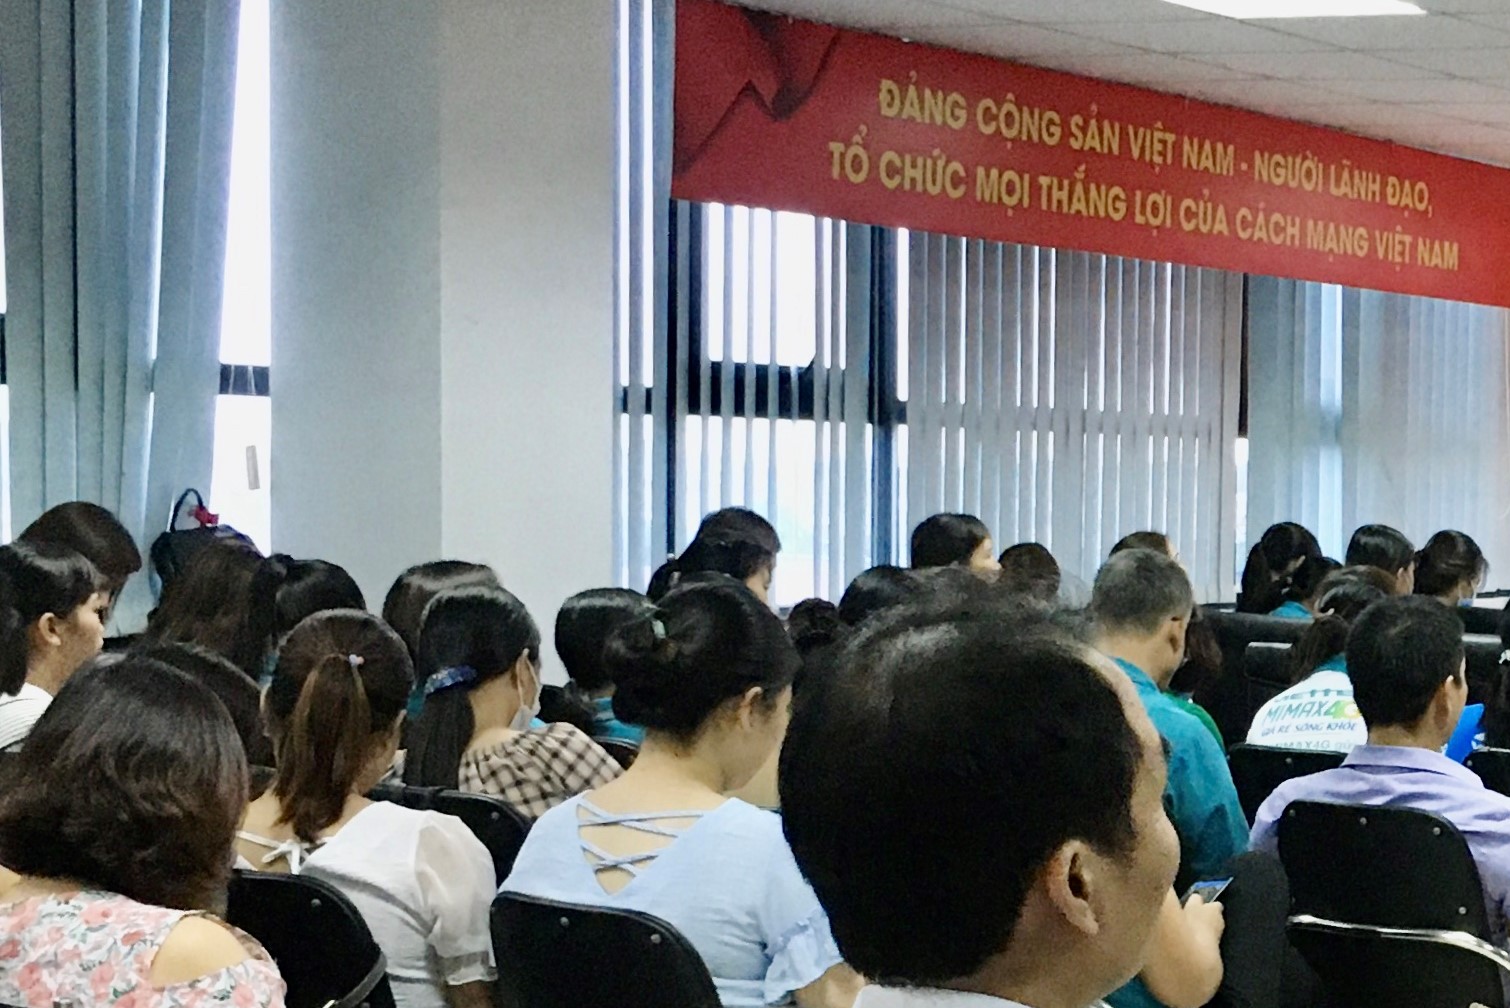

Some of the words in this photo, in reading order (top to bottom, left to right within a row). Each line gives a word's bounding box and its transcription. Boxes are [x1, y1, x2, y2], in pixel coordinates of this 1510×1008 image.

[829, 124, 870, 184] TỔ
[879, 147, 967, 199] CHỨC
[976, 166, 1029, 216] MỌI
[1038, 163, 1128, 221] THẮNG
[1135, 190, 1172, 236] LỢI
[1179, 188, 1229, 236] CỦA
[1236, 202, 1300, 248] CÁCH
[1307, 220, 1369, 262] MẠNG
[1375, 225, 1413, 272] VIỆT
[1417, 238, 1459, 271] NAM
[878, 70, 967, 129] ĐẢNG
[977, 93, 1062, 149] CỘNG
[1069, 103, 1120, 155] SẢN
[1128, 122, 1176, 174] VIỆT
[1182, 137, 1234, 176] NAM
[1254, 149, 1324, 193] NGƯỜI
[1329, 161, 1381, 203] LÃNH
[1386, 176, 1433, 218] ĐẠO,
